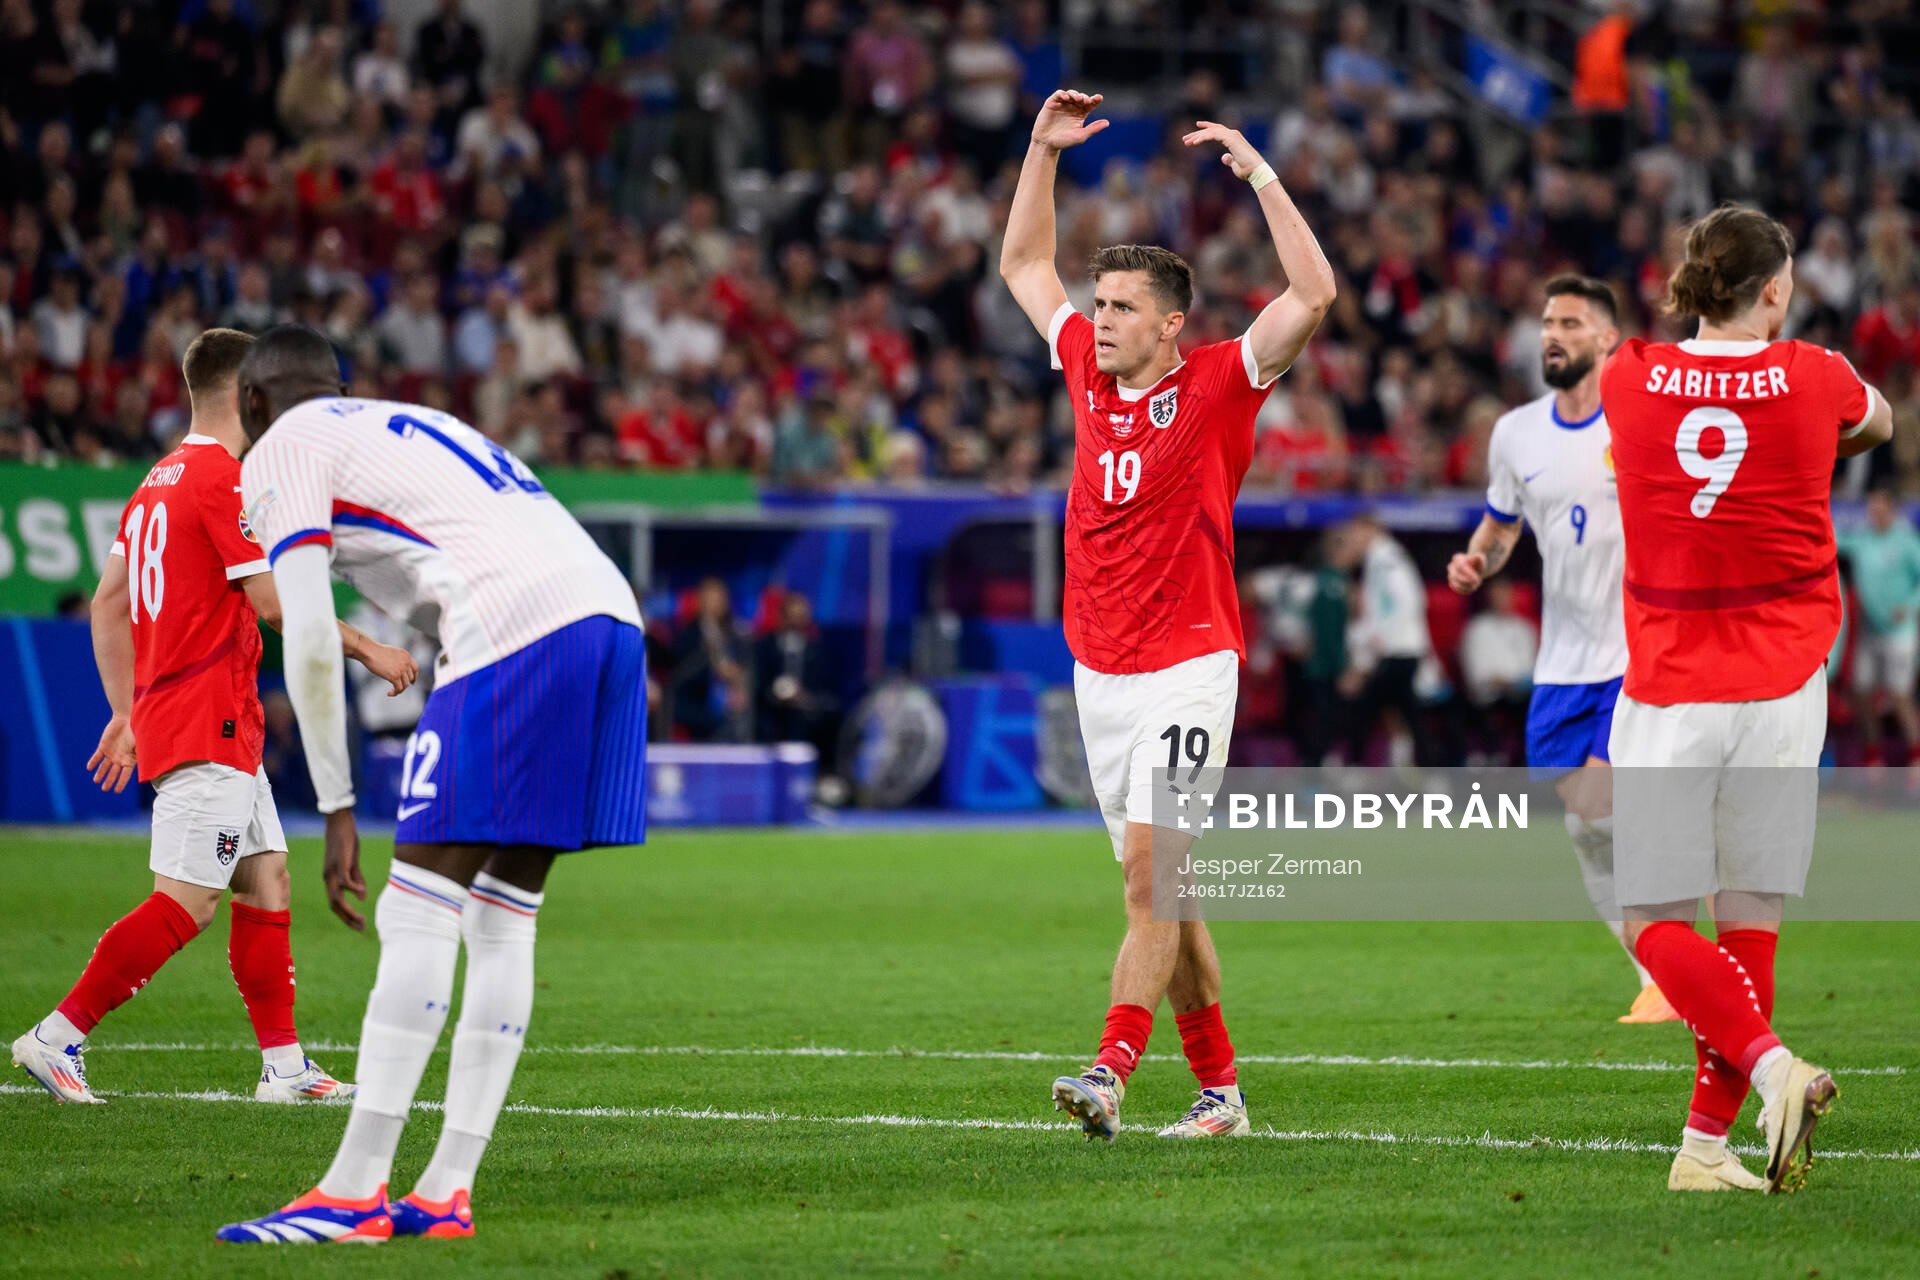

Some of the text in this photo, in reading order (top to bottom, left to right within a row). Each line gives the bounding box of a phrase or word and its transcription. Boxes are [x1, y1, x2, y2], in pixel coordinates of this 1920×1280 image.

[1645, 364, 1790, 399] SABITZER
[1098, 449, 1142, 505] 19
[1674, 405, 1749, 519] 9
[1570, 504, 1587, 545] 9
[124, 501, 168, 625] 18
[400, 729, 441, 799] 12
[1160, 723, 1211, 785] 19
